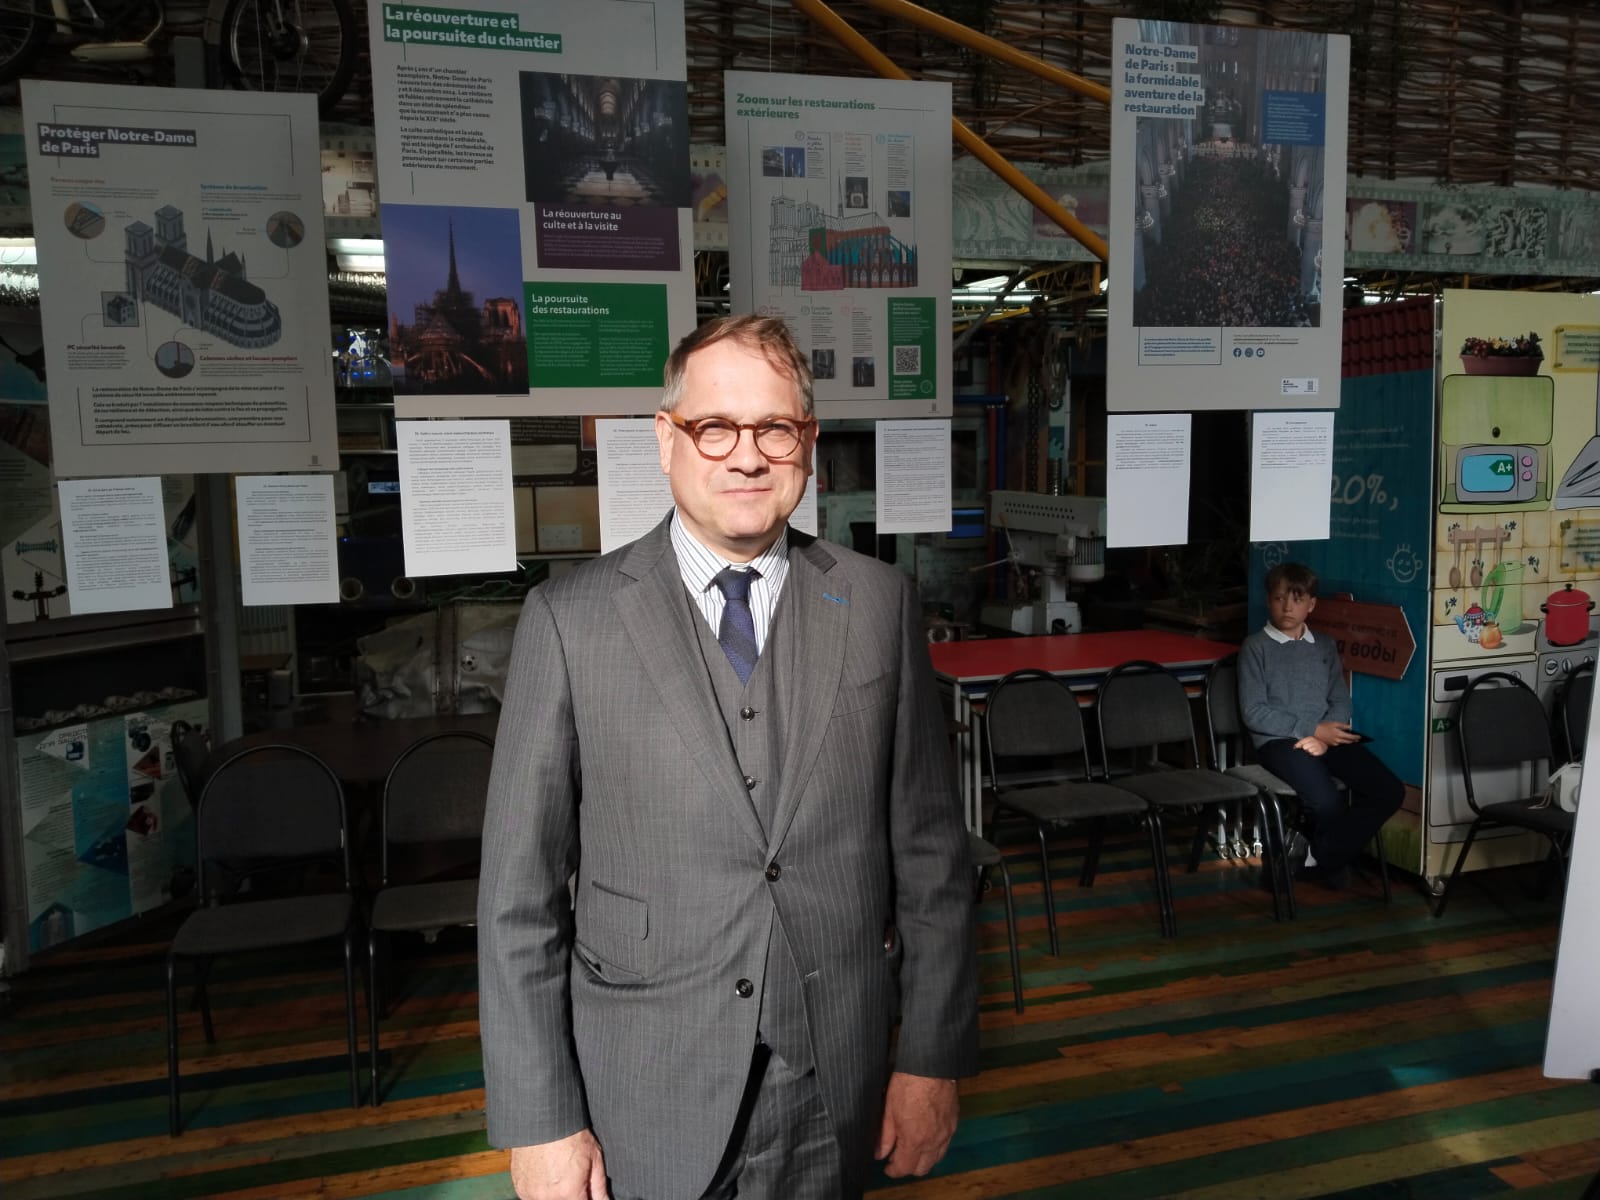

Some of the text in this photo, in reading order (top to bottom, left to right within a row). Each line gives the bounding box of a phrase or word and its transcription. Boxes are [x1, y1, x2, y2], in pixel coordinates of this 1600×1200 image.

[386, 7, 518, 28] La réouverture et
[387, 25, 560, 50] la poursuite du chantier
[1125, 44, 1196, 59] Notre-Dame
[1125, 58, 1140, 70] de
[1141, 60, 1168, 72] Paris
[1125, 72, 1200, 88] la formidable
[736, 93, 876, 110] Zoom sur les restaurations
[1124, 90, 1203, 102] aventure de la
[736, 108, 800, 120] extérieures
[1124, 104, 1194, 115] restauration
[40, 126, 194, 144] Protéger Notre-Dame
[42, 142, 97, 156] de Paris
[542, 208, 621, 220] La réouverture au
[543, 220, 618, 231] culte et à la visite
[532, 294, 588, 304] La poursuite
[532, 306, 610, 315] des restaurations
[1498, 462, 1512, 473] A+
[1350, 640, 1396, 663] воды
